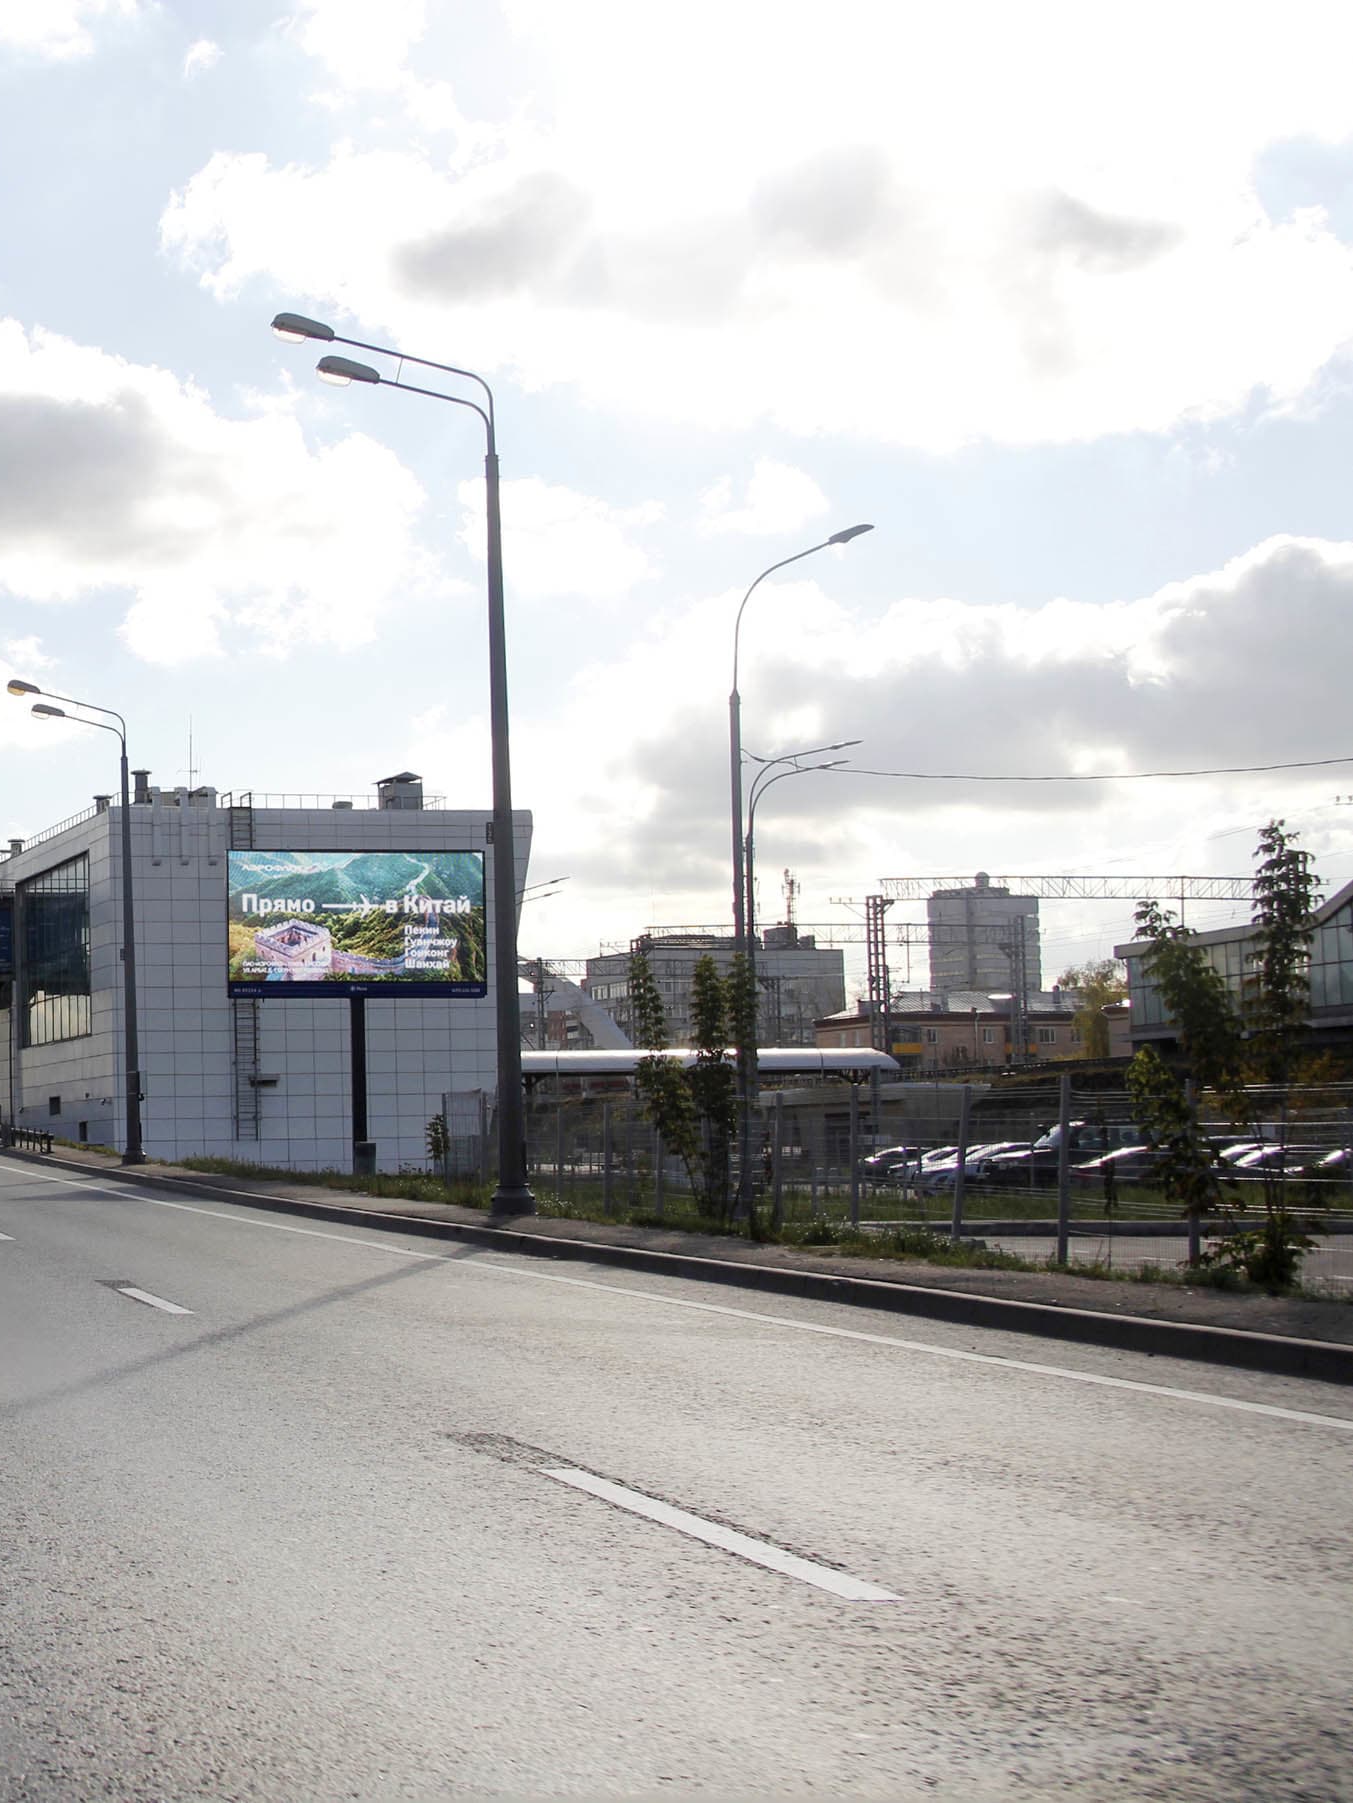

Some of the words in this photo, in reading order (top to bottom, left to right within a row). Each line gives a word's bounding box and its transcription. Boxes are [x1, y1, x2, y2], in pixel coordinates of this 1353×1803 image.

[242, 893, 315, 917] Прямо
[385, 899, 399, 914] в
[404, 895, 471, 914] Китай
[404, 925, 440, 935] Пекин
[404, 936, 457, 949] Гуанчжоу
[404, 948, 450, 958] Гонконг
[404, 957, 450, 969] Шанхай
